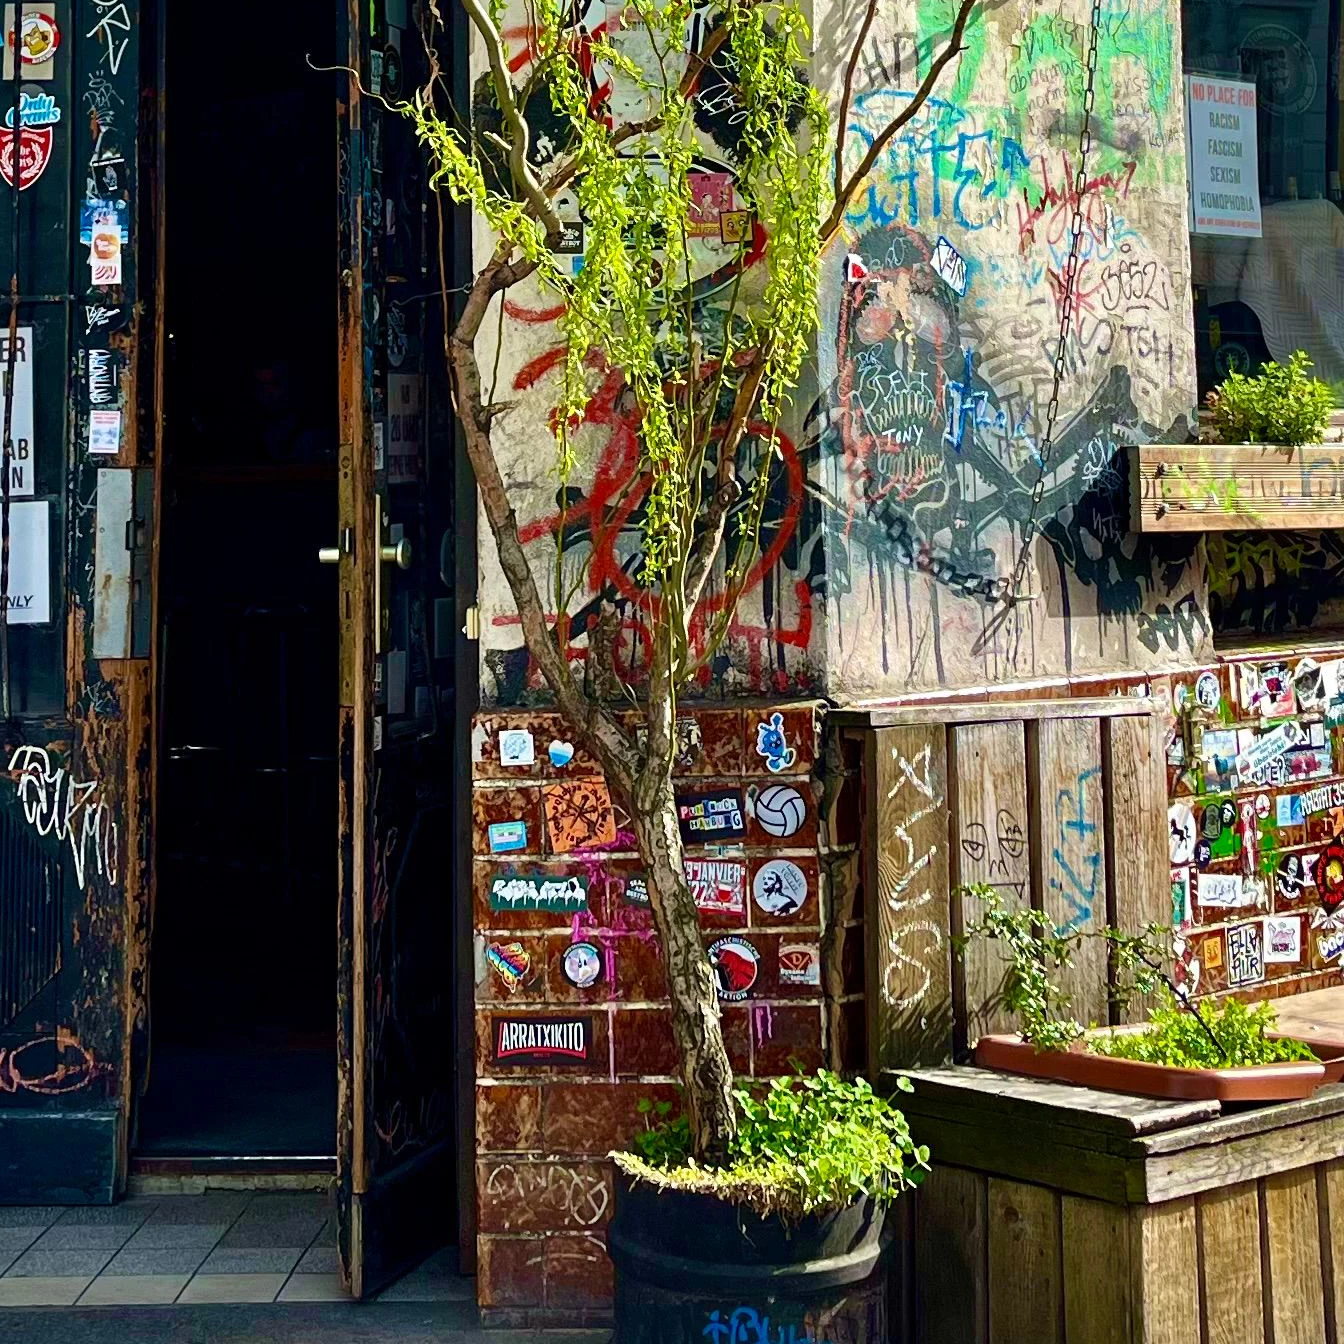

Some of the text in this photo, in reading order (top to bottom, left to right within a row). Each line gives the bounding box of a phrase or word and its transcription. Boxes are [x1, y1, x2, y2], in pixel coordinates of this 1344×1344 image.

[1192, 83, 1256, 106] NO PLACE FOR
[1209, 112, 1241, 130] RACISM
[1208, 138, 1243, 157] FASCISM
[1210, 165, 1242, 184] SEXISM
[1200, 191, 1256, 212] HOMOPHOBIA
[2, 438, 30, 462] AB
[499, 1021, 585, 1053] ARRATXIKITO
